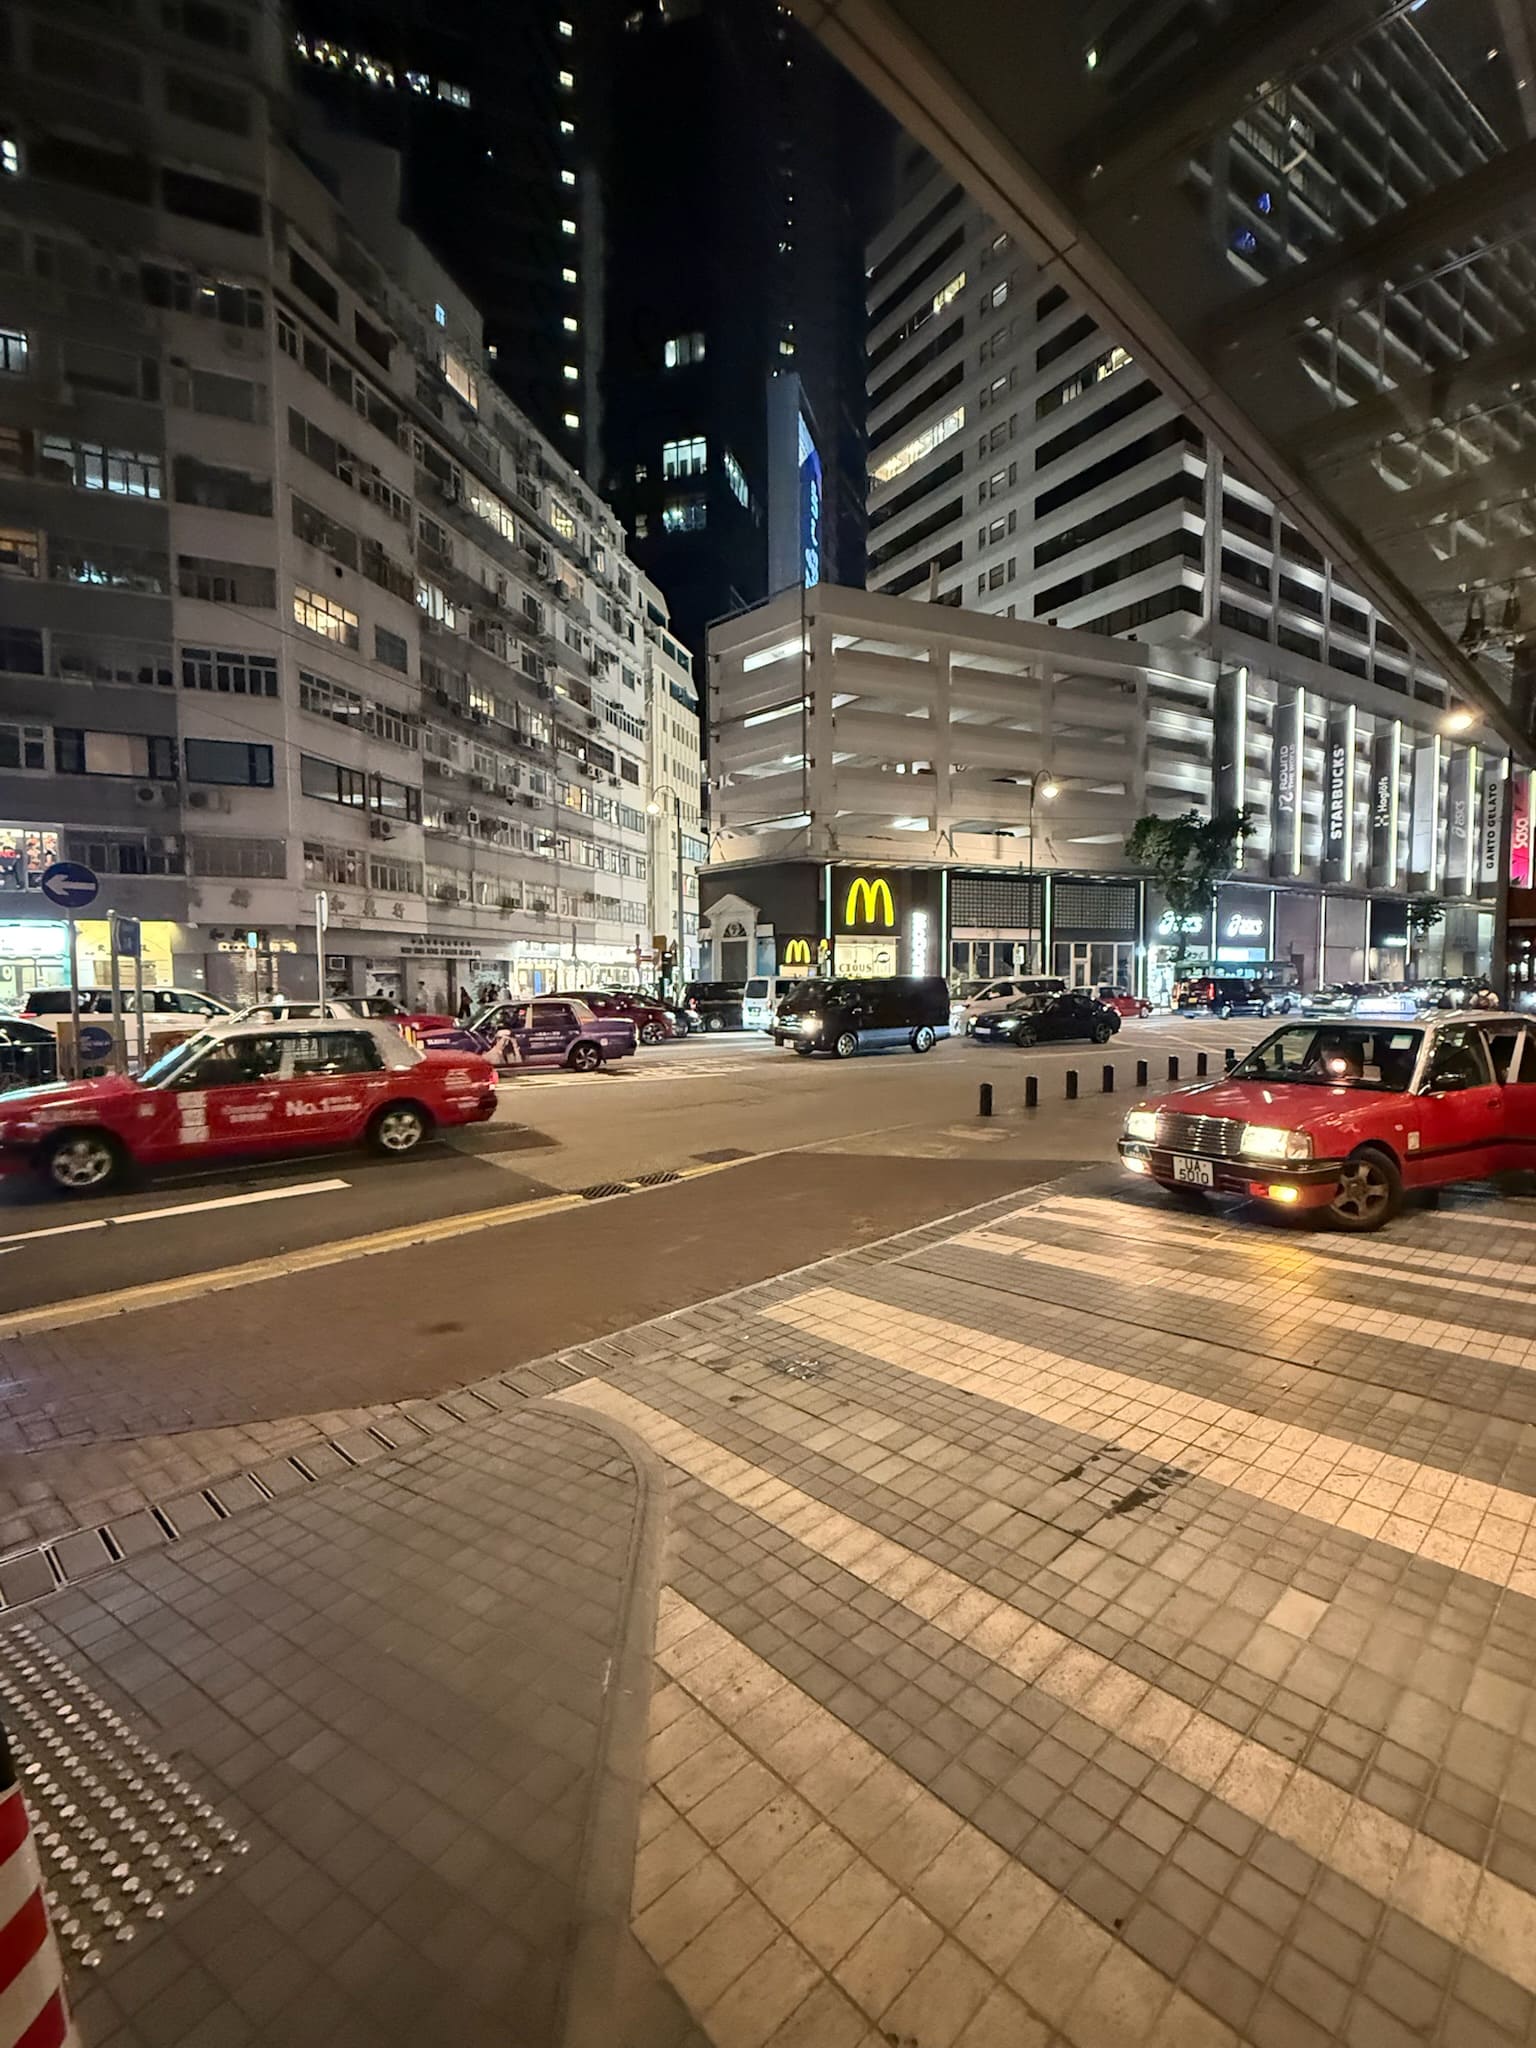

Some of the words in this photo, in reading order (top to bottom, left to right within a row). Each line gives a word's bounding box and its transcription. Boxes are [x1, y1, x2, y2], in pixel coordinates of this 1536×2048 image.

[1330, 747, 1345, 840] STARBUCKS
[1487, 783, 1497, 827] GELATO
[1486, 830, 1496, 869] GANTO
[1179, 1168, 1209, 1185] 5010
[1185, 1159, 1202, 1173] UA
